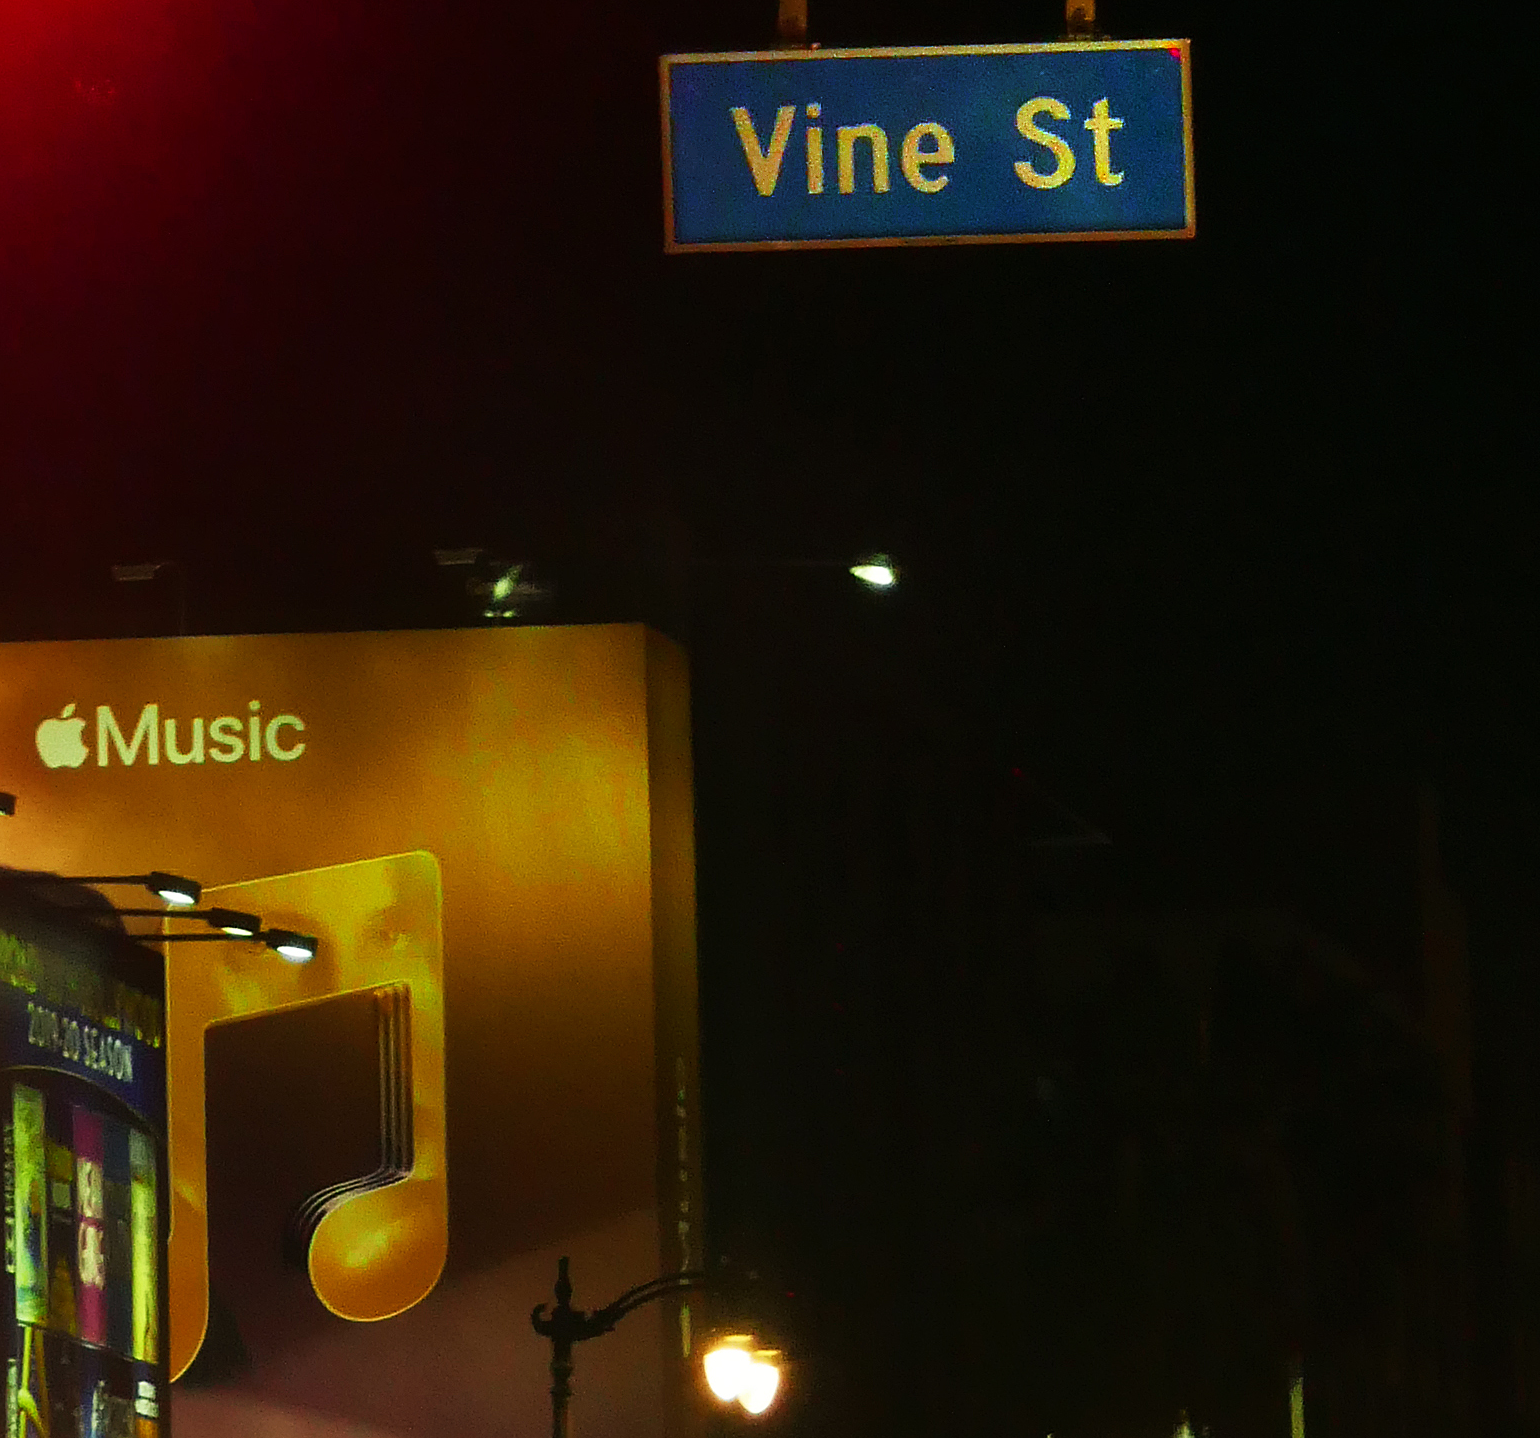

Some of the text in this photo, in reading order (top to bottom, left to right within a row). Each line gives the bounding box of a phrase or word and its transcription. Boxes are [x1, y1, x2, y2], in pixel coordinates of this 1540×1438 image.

[728, 94, 1126, 198] Vine St
[96, 699, 306, 767] Music
